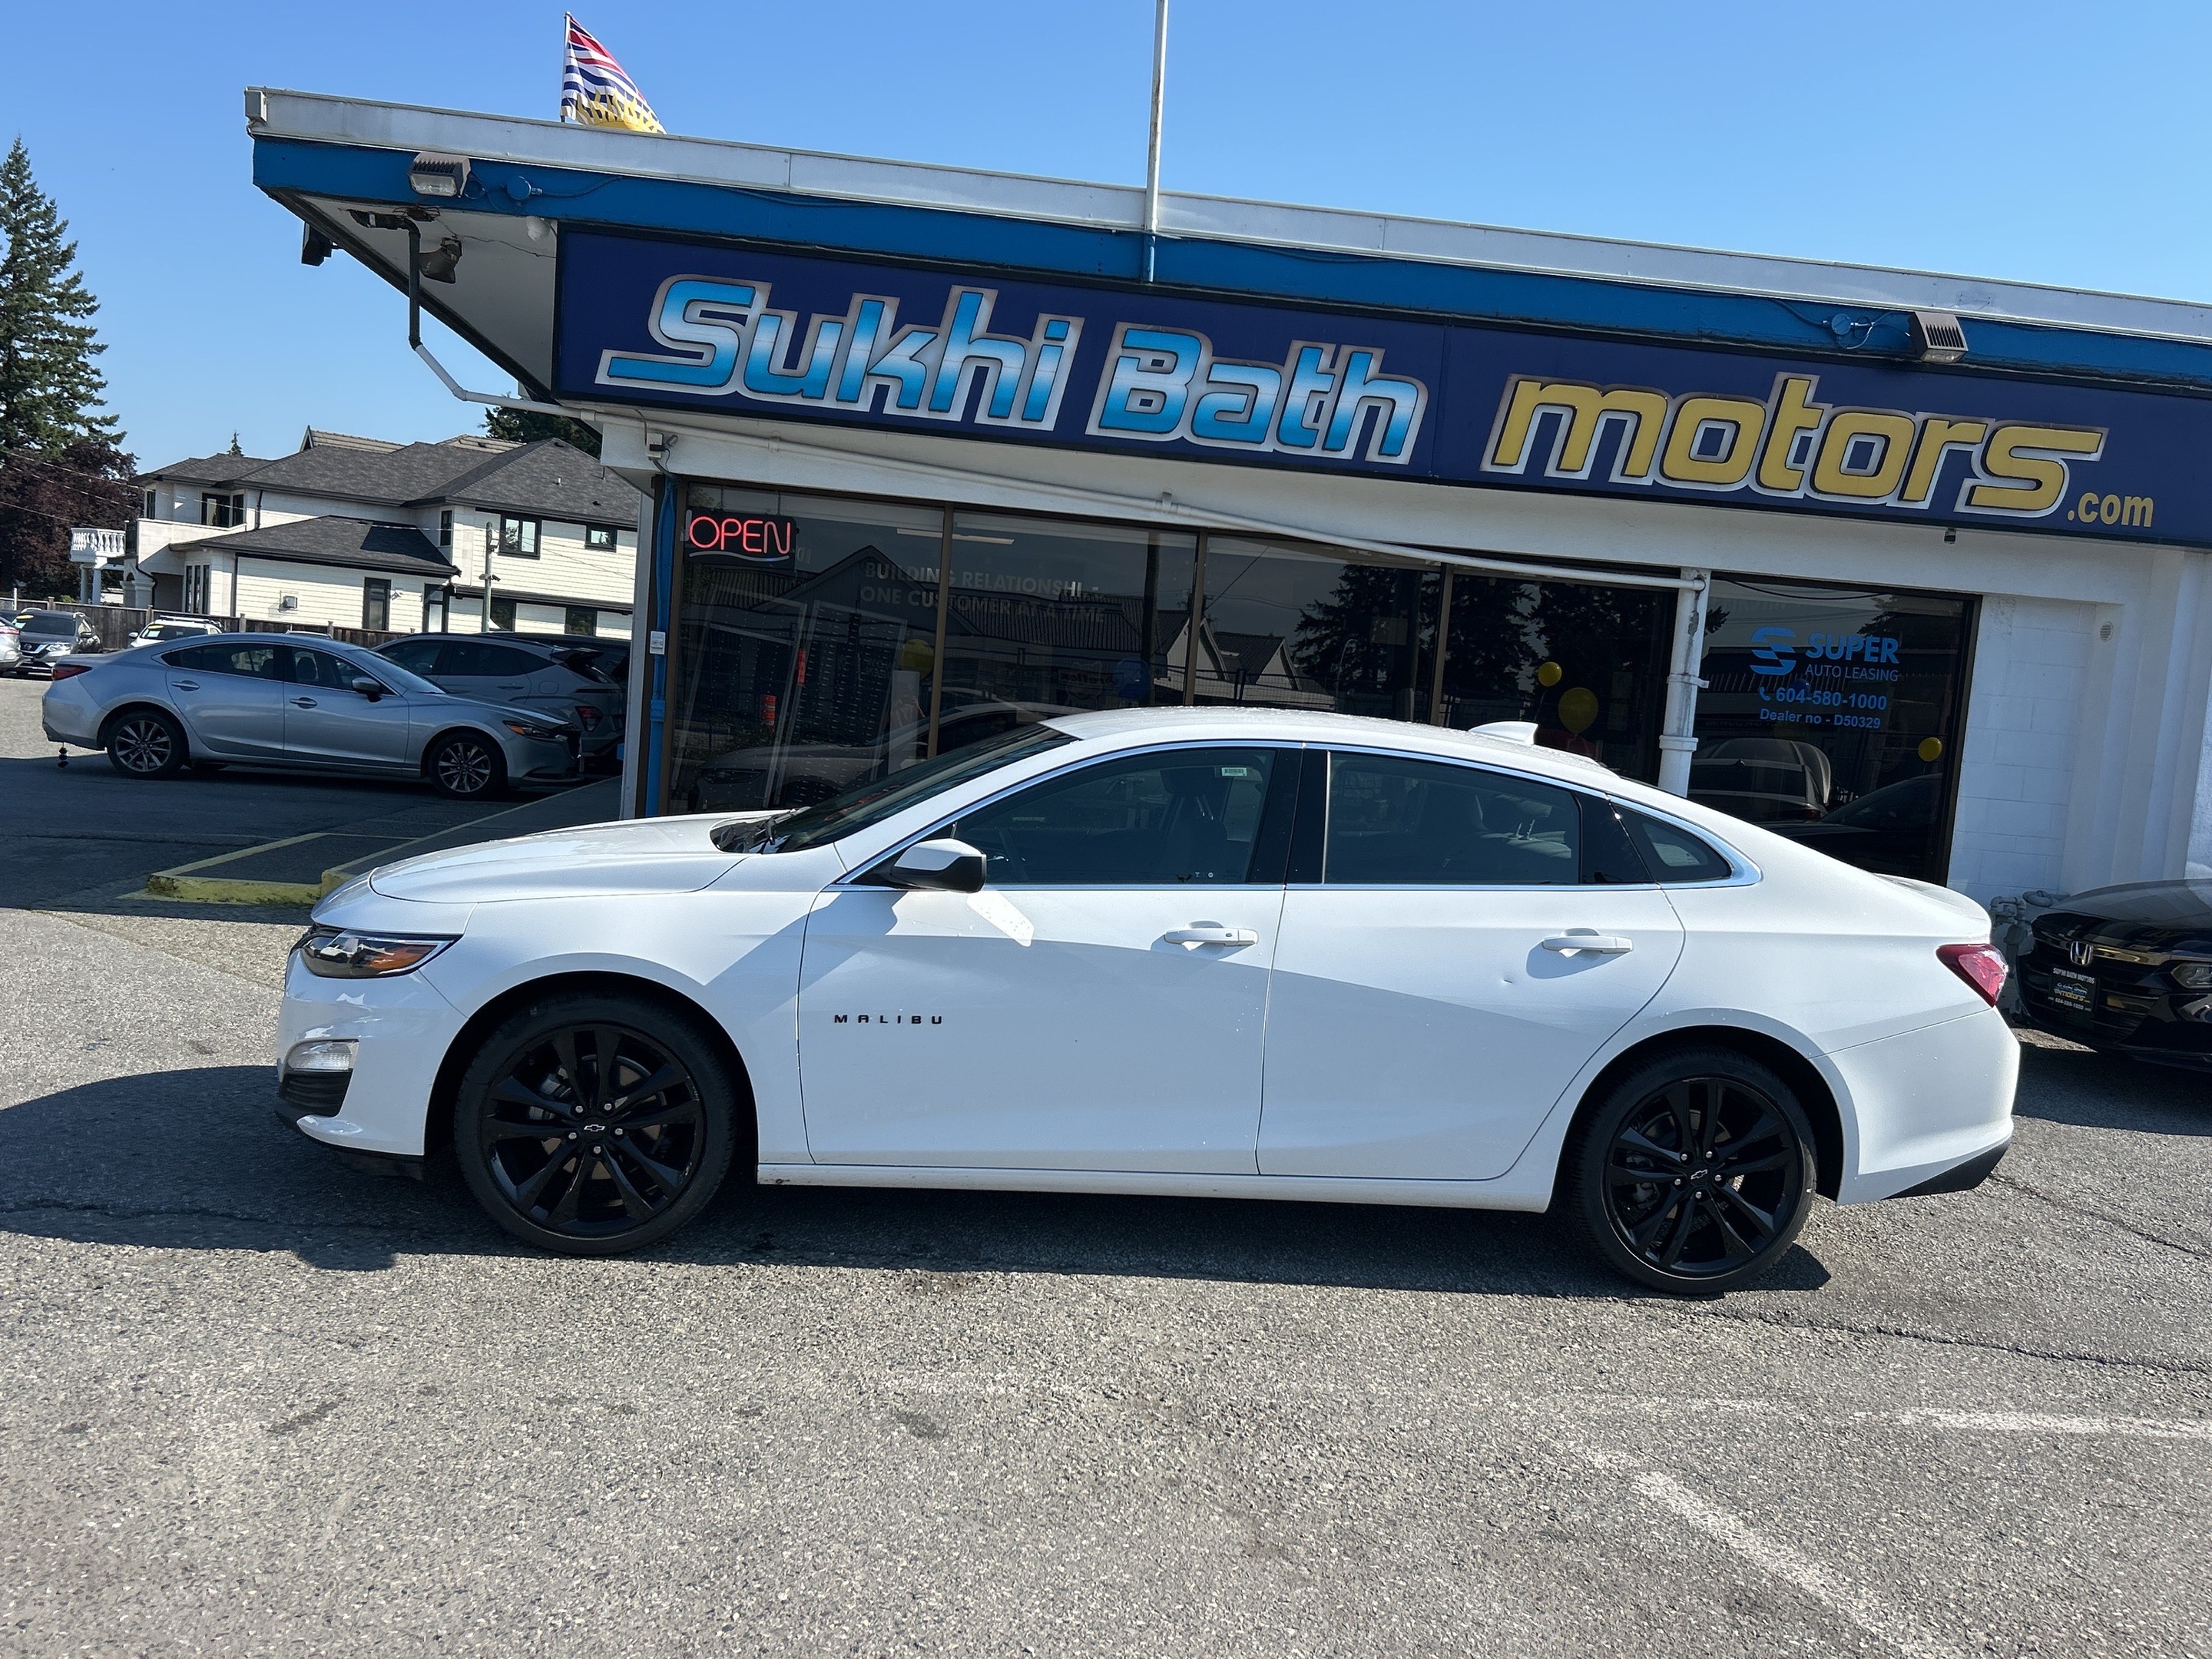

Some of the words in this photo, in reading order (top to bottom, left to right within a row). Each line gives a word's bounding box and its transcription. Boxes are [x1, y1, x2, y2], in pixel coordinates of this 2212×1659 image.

[594, 273, 1084, 431] Sukhi
[1085, 322, 1428, 465] Bath
[1479, 372, 2109, 518] motors
[2067, 491, 2154, 528] .com
[688, 515, 792, 555] OPEN
[860, 586, 902, 604] ONE
[962, 571, 1101, 598] RELATIONSHI
[1806, 632, 1899, 664] SUPER
[1805, 664, 1842, 677] AUTO
[1845, 667, 1899, 682] LEASING
[1776, 687, 1887, 710] 604-580-1000
[1760, 708, 1802, 722] Dealer
[1805, 714, 1822, 724] no
[1834, 714, 1880, 729] D50329
[834, 1015, 942, 1025] MALIBU
